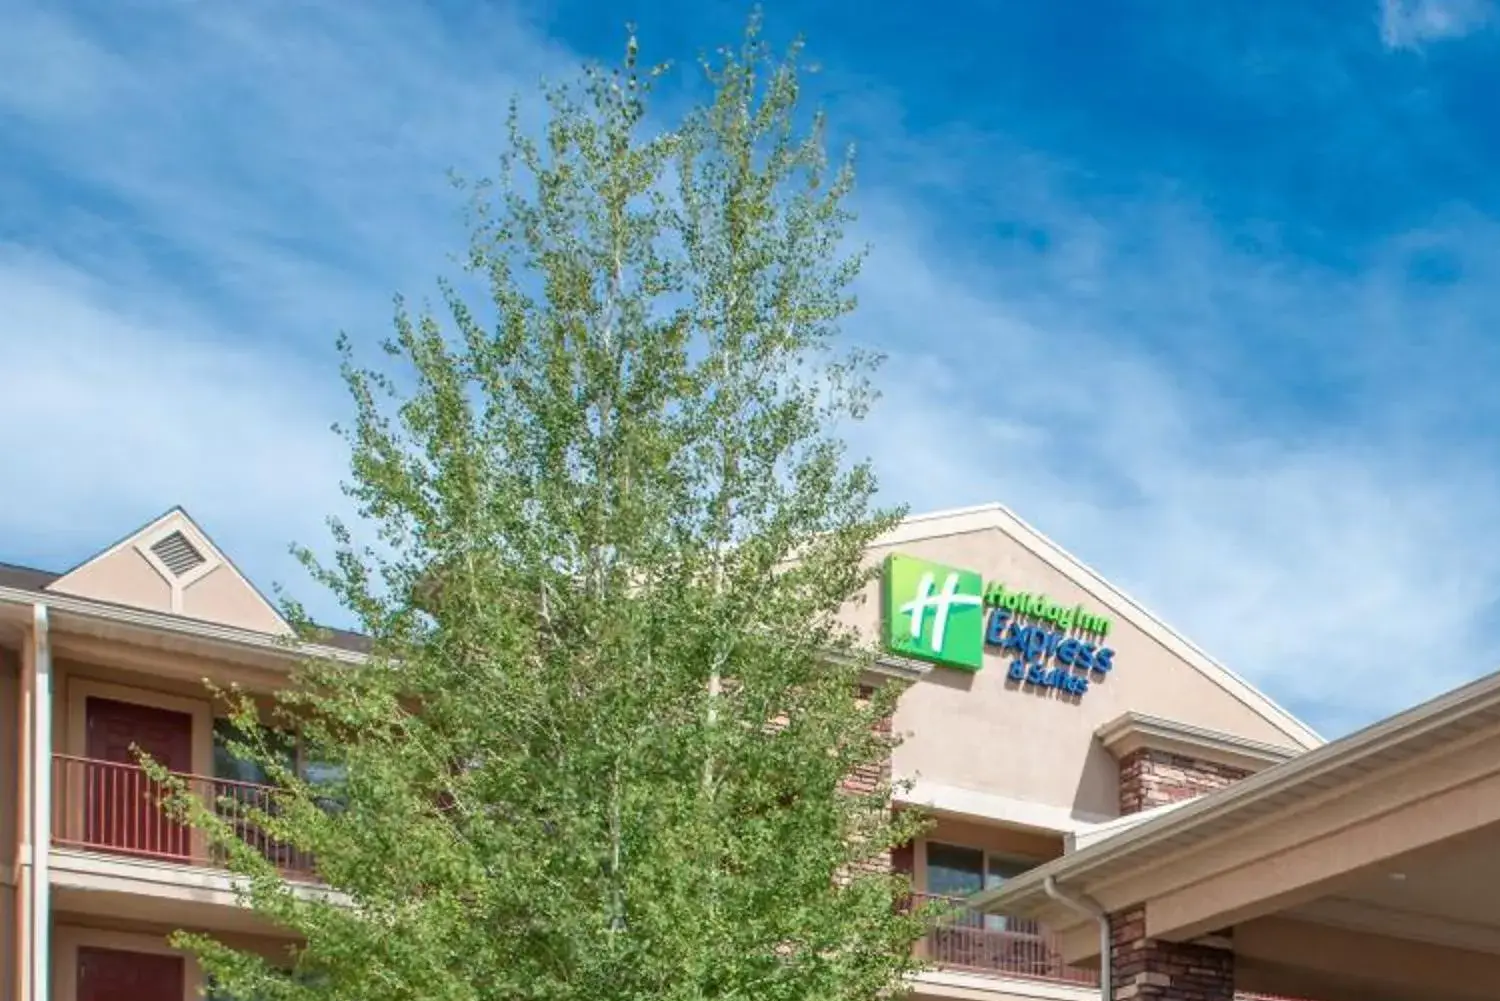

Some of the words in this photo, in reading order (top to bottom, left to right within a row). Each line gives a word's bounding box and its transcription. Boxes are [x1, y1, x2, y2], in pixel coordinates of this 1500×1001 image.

[983, 580, 1072, 632] Holiday
[1071, 602, 1112, 637] Inn
[984, 607, 1116, 673] Express
[1008, 658, 1025, 681] &
[1027, 660, 1089, 696] Suites
